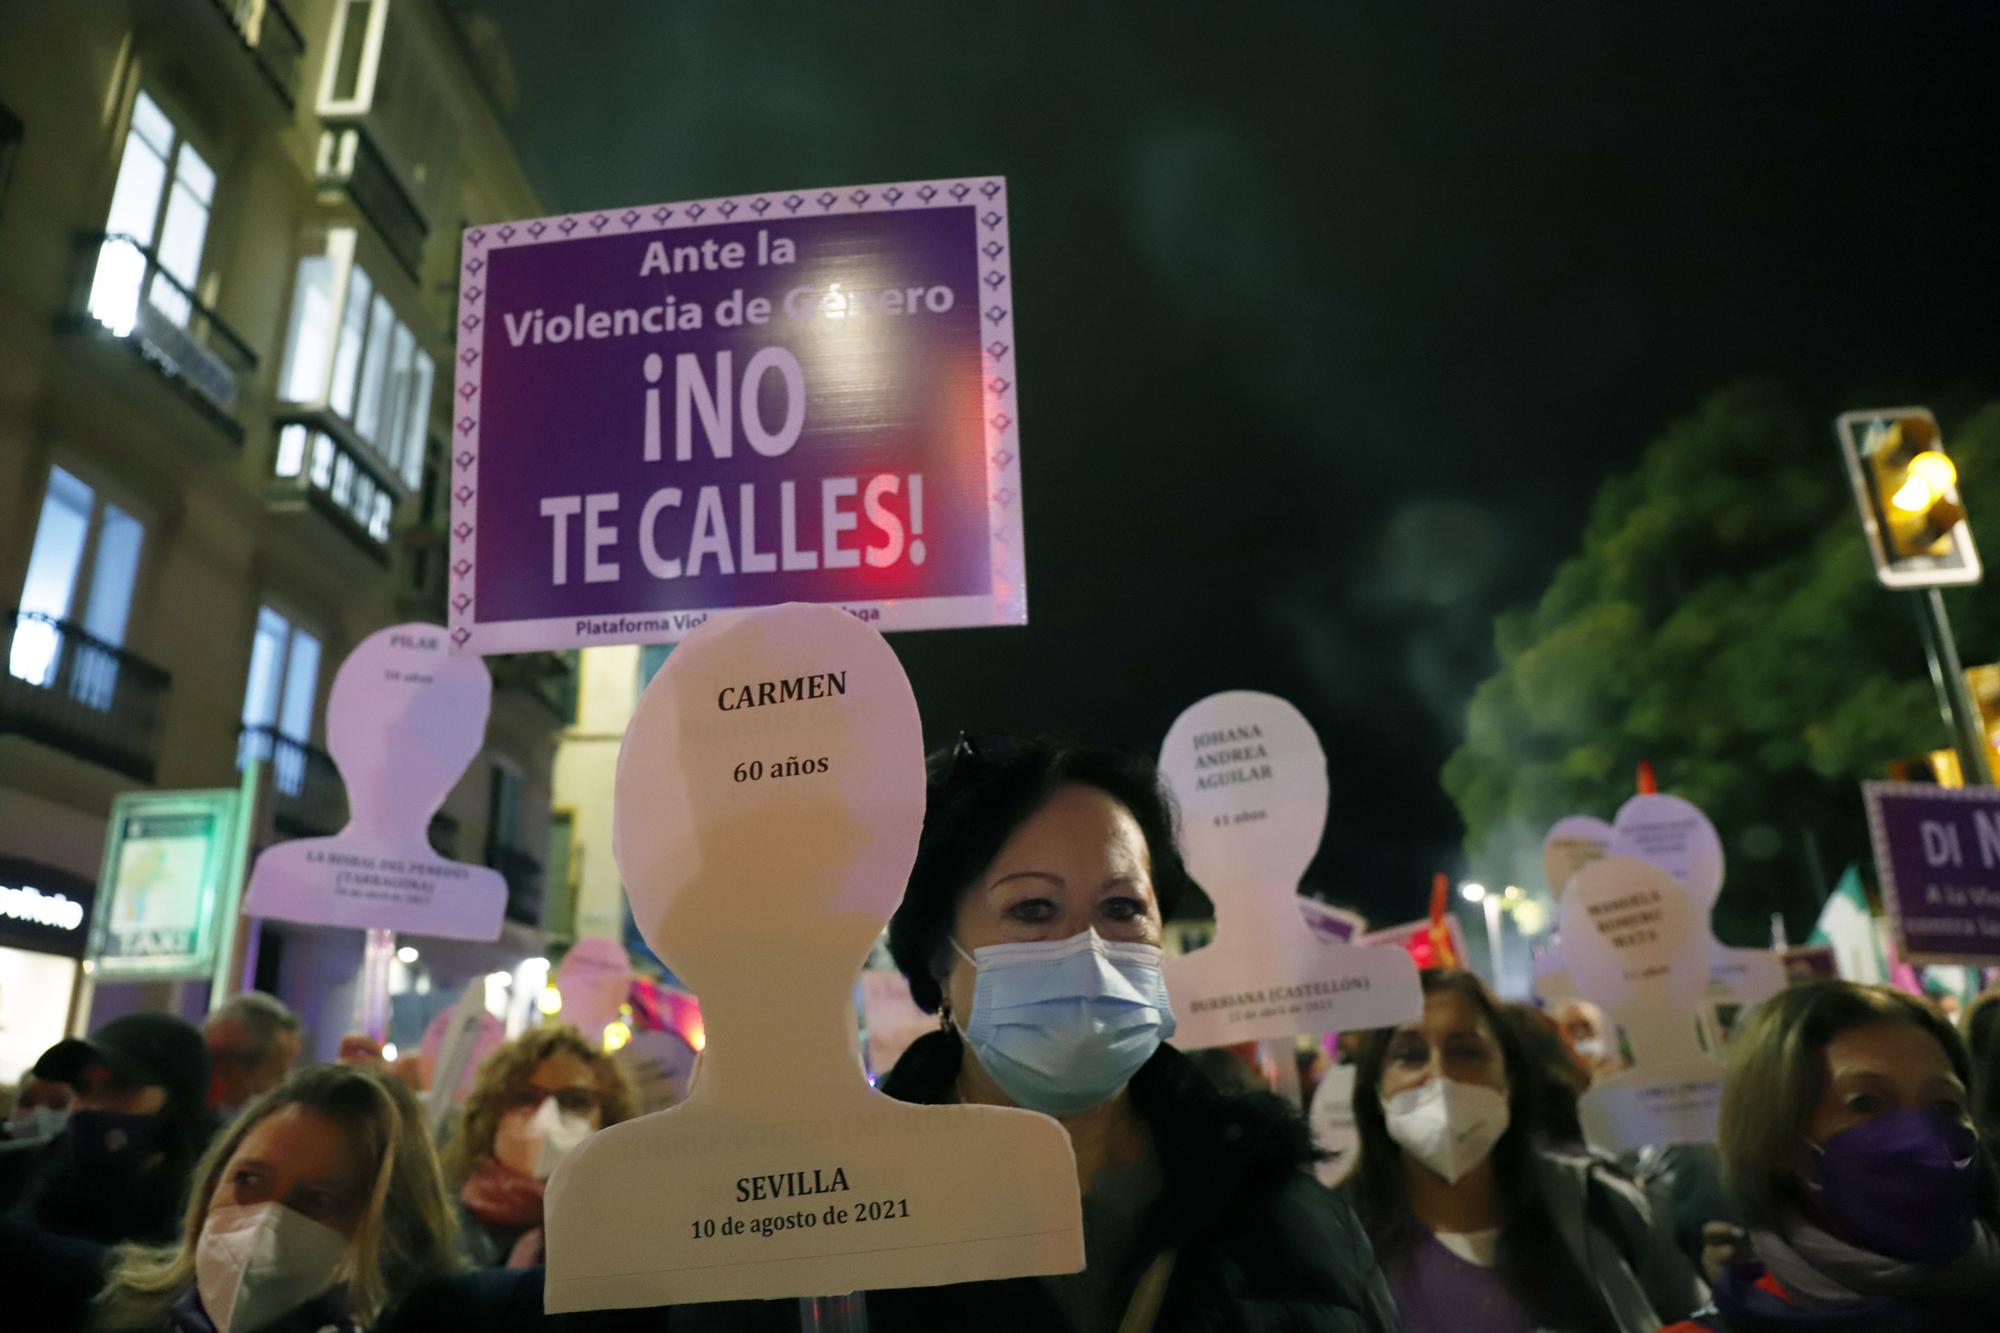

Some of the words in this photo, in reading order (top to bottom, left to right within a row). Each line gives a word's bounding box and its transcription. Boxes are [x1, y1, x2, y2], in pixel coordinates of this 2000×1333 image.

[639, 240, 745, 277] Ante
[757, 230, 796, 266] la
[503, 296, 703, 347] Violencia
[714, 289, 772, 328] de
[643, 346, 806, 462] ¡NO
[540, 492, 620, 587] TE
[638, 473, 925, 581] CALLES!
[389, 634, 439, 651] PILAR
[576, 615, 670, 637] Plataforma
[718, 671, 847, 711] CARMEN
[1193, 725, 1262, 751] JOHANA
[1194, 744, 1269, 769] ANDREA
[733, 760, 763, 783] 60
[770, 756, 829, 779] años
[1195, 764, 1273, 792] AGUILAR
[1921, 820, 1963, 868] DI
[1973, 809, 2000, 870] N
[736, 1167, 850, 1203] SEVILLA
[691, 1219, 715, 1239] 10
[721, 1217, 744, 1235] de
[750, 1210, 816, 1237] agosto
[823, 1206, 848, 1225] de
[855, 1199, 911, 1222] 2021
